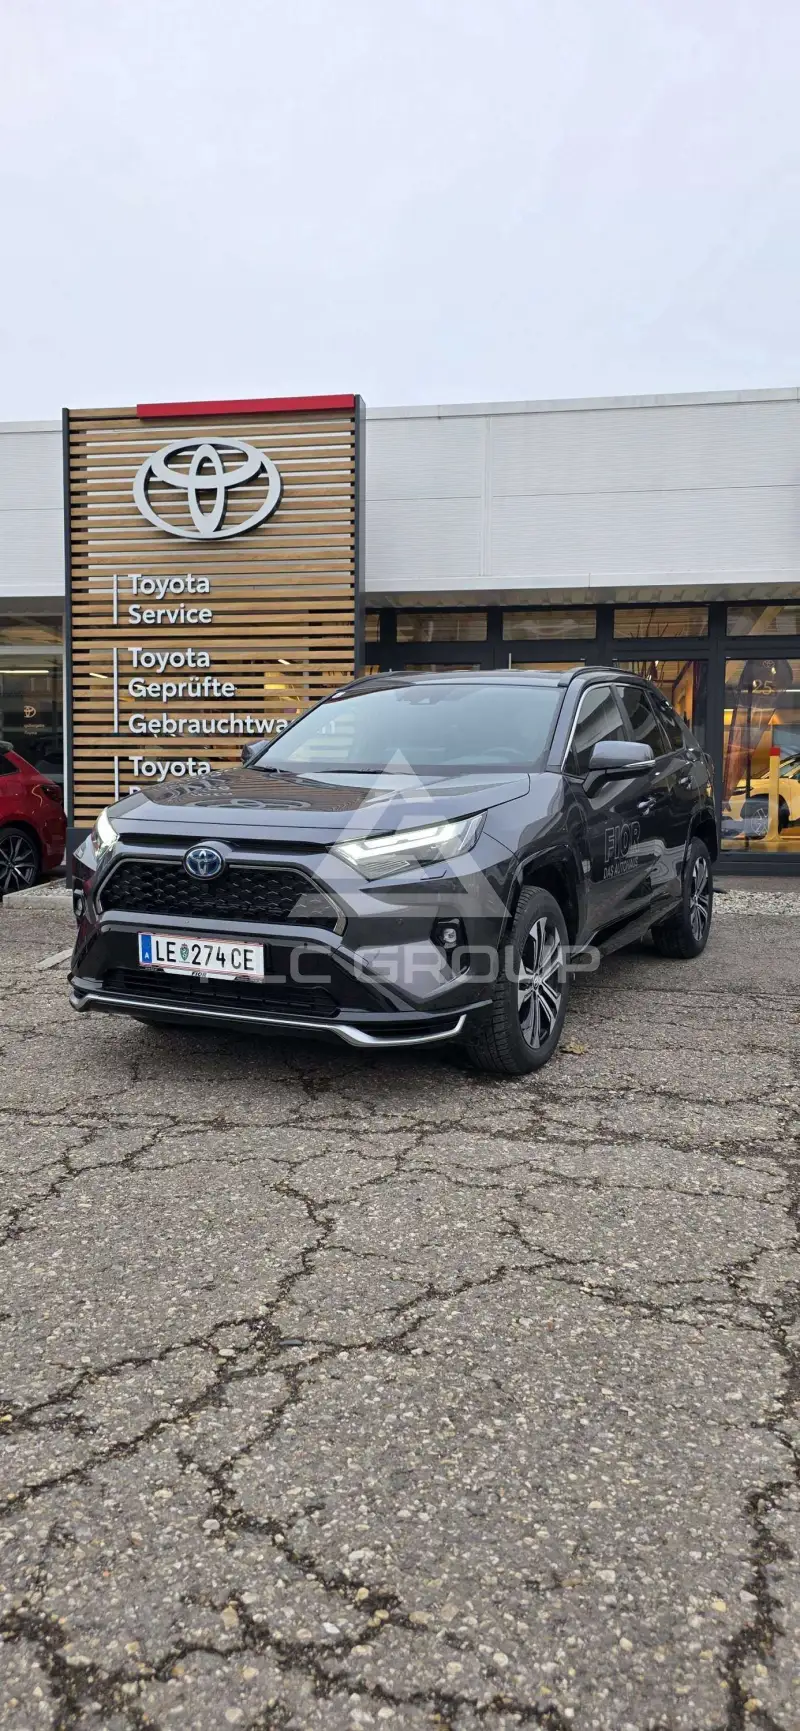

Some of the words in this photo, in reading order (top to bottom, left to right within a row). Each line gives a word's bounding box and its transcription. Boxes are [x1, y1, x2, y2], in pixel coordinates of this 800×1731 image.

[128, 574, 211, 599] Toyota
[128, 603, 213, 624] Service
[128, 647, 211, 673] Toyota
[128, 677, 236, 703] Geprüfte
[752, 679, 774, 695] 25
[128, 713, 335, 734] Gebrauchtwan
[128, 756, 211, 781] Toyota
[604, 821, 641, 863] FIOR
[603, 864, 614, 879] DAS
[144, 952, 150, 960] A
[155, 940, 176, 962] LE
[191, 943, 226, 967] 274
[231, 948, 254, 970] CE
